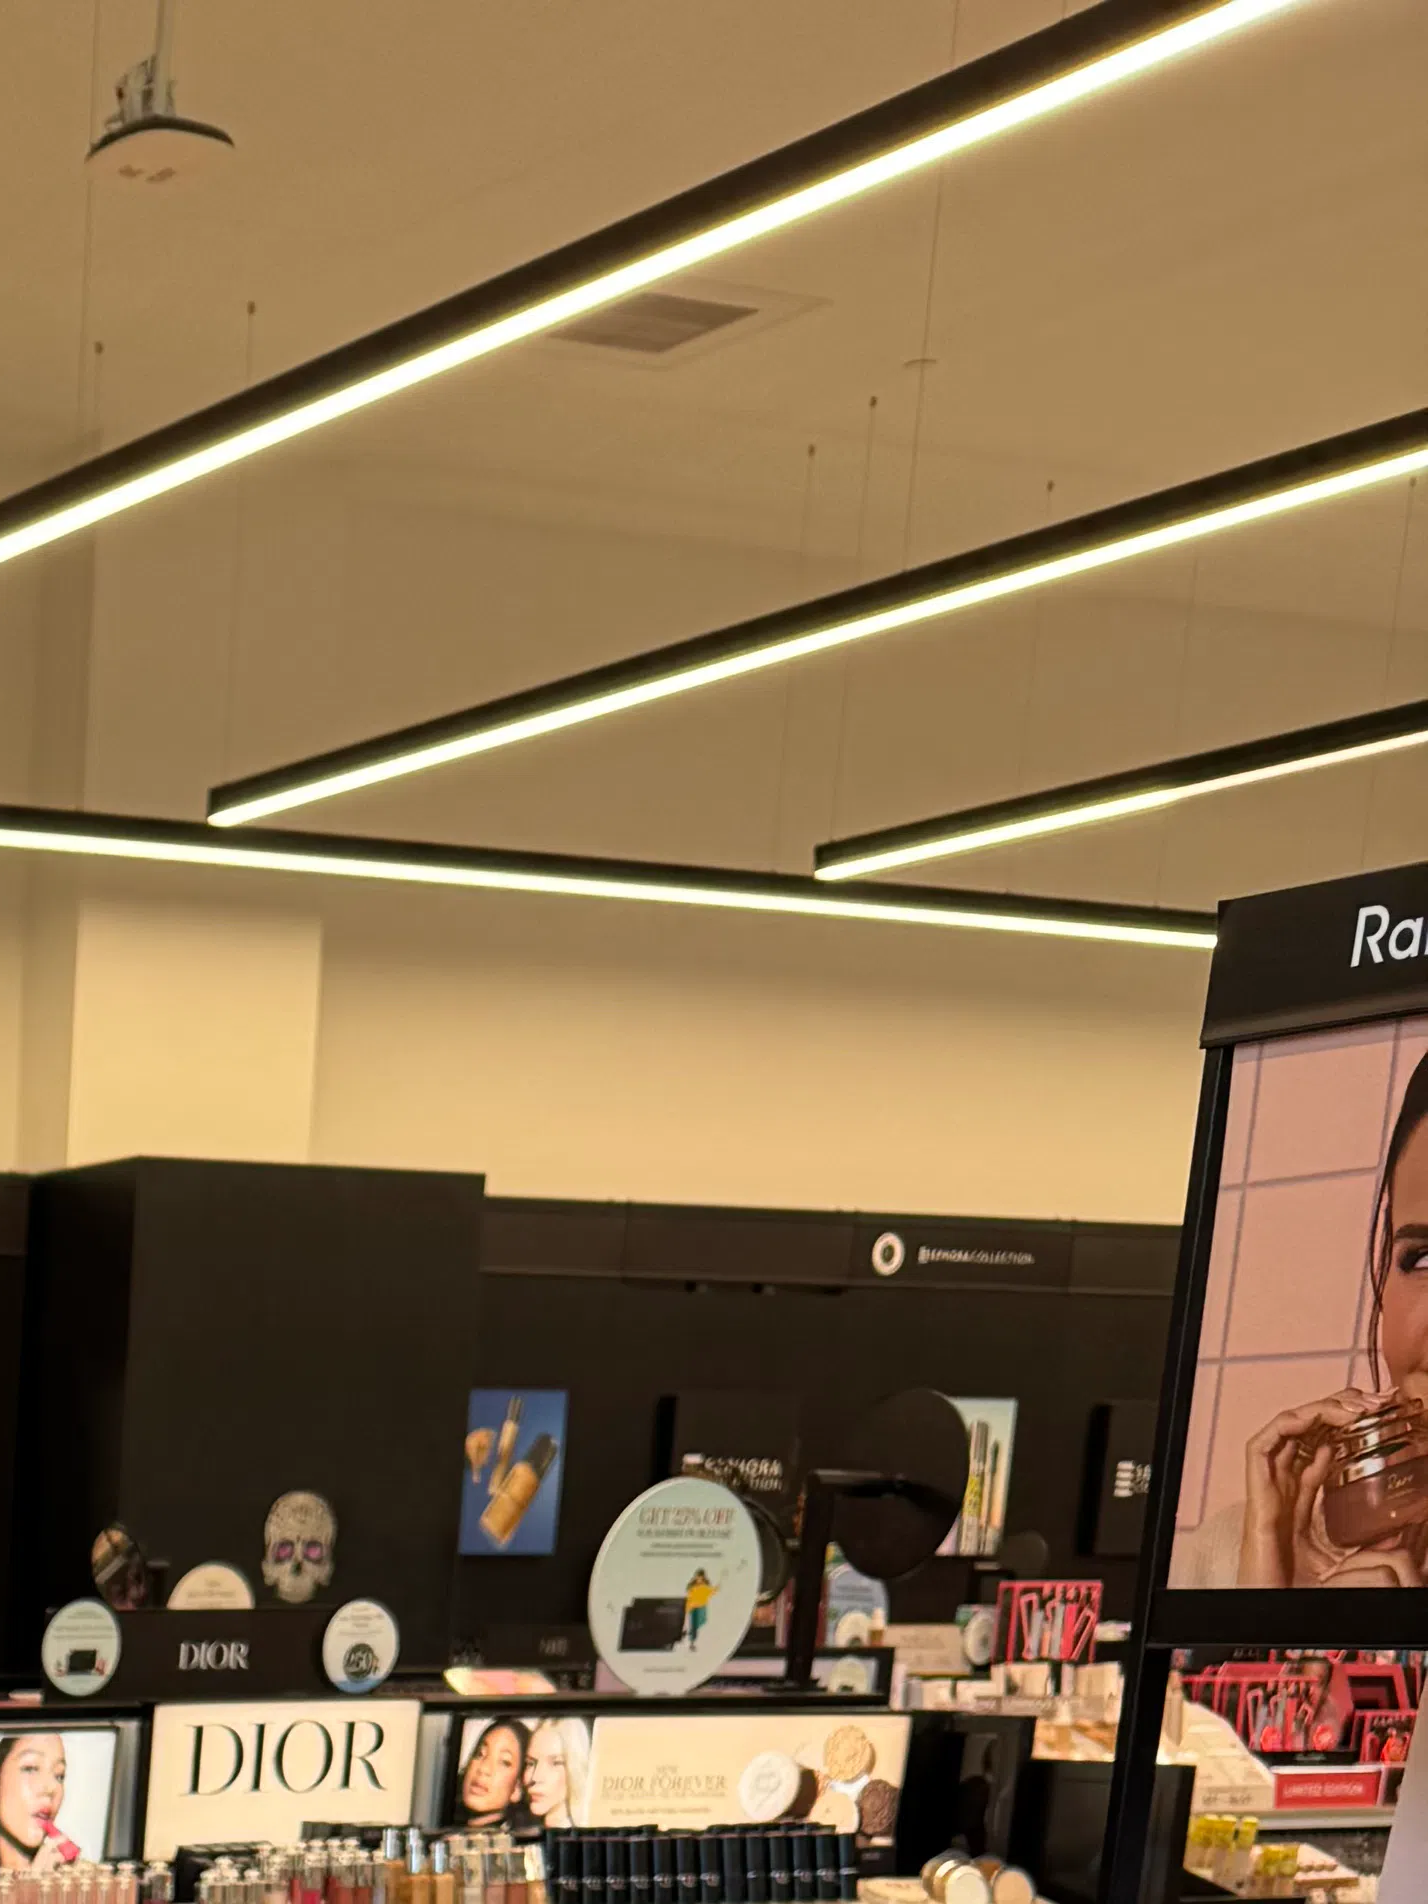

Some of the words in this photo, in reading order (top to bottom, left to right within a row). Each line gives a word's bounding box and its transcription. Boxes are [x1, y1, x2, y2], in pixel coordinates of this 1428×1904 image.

[1350, 904, 1428, 967] Ra
[178, 1640, 251, 1671] DIOR
[179, 1719, 388, 1796] DIOR
